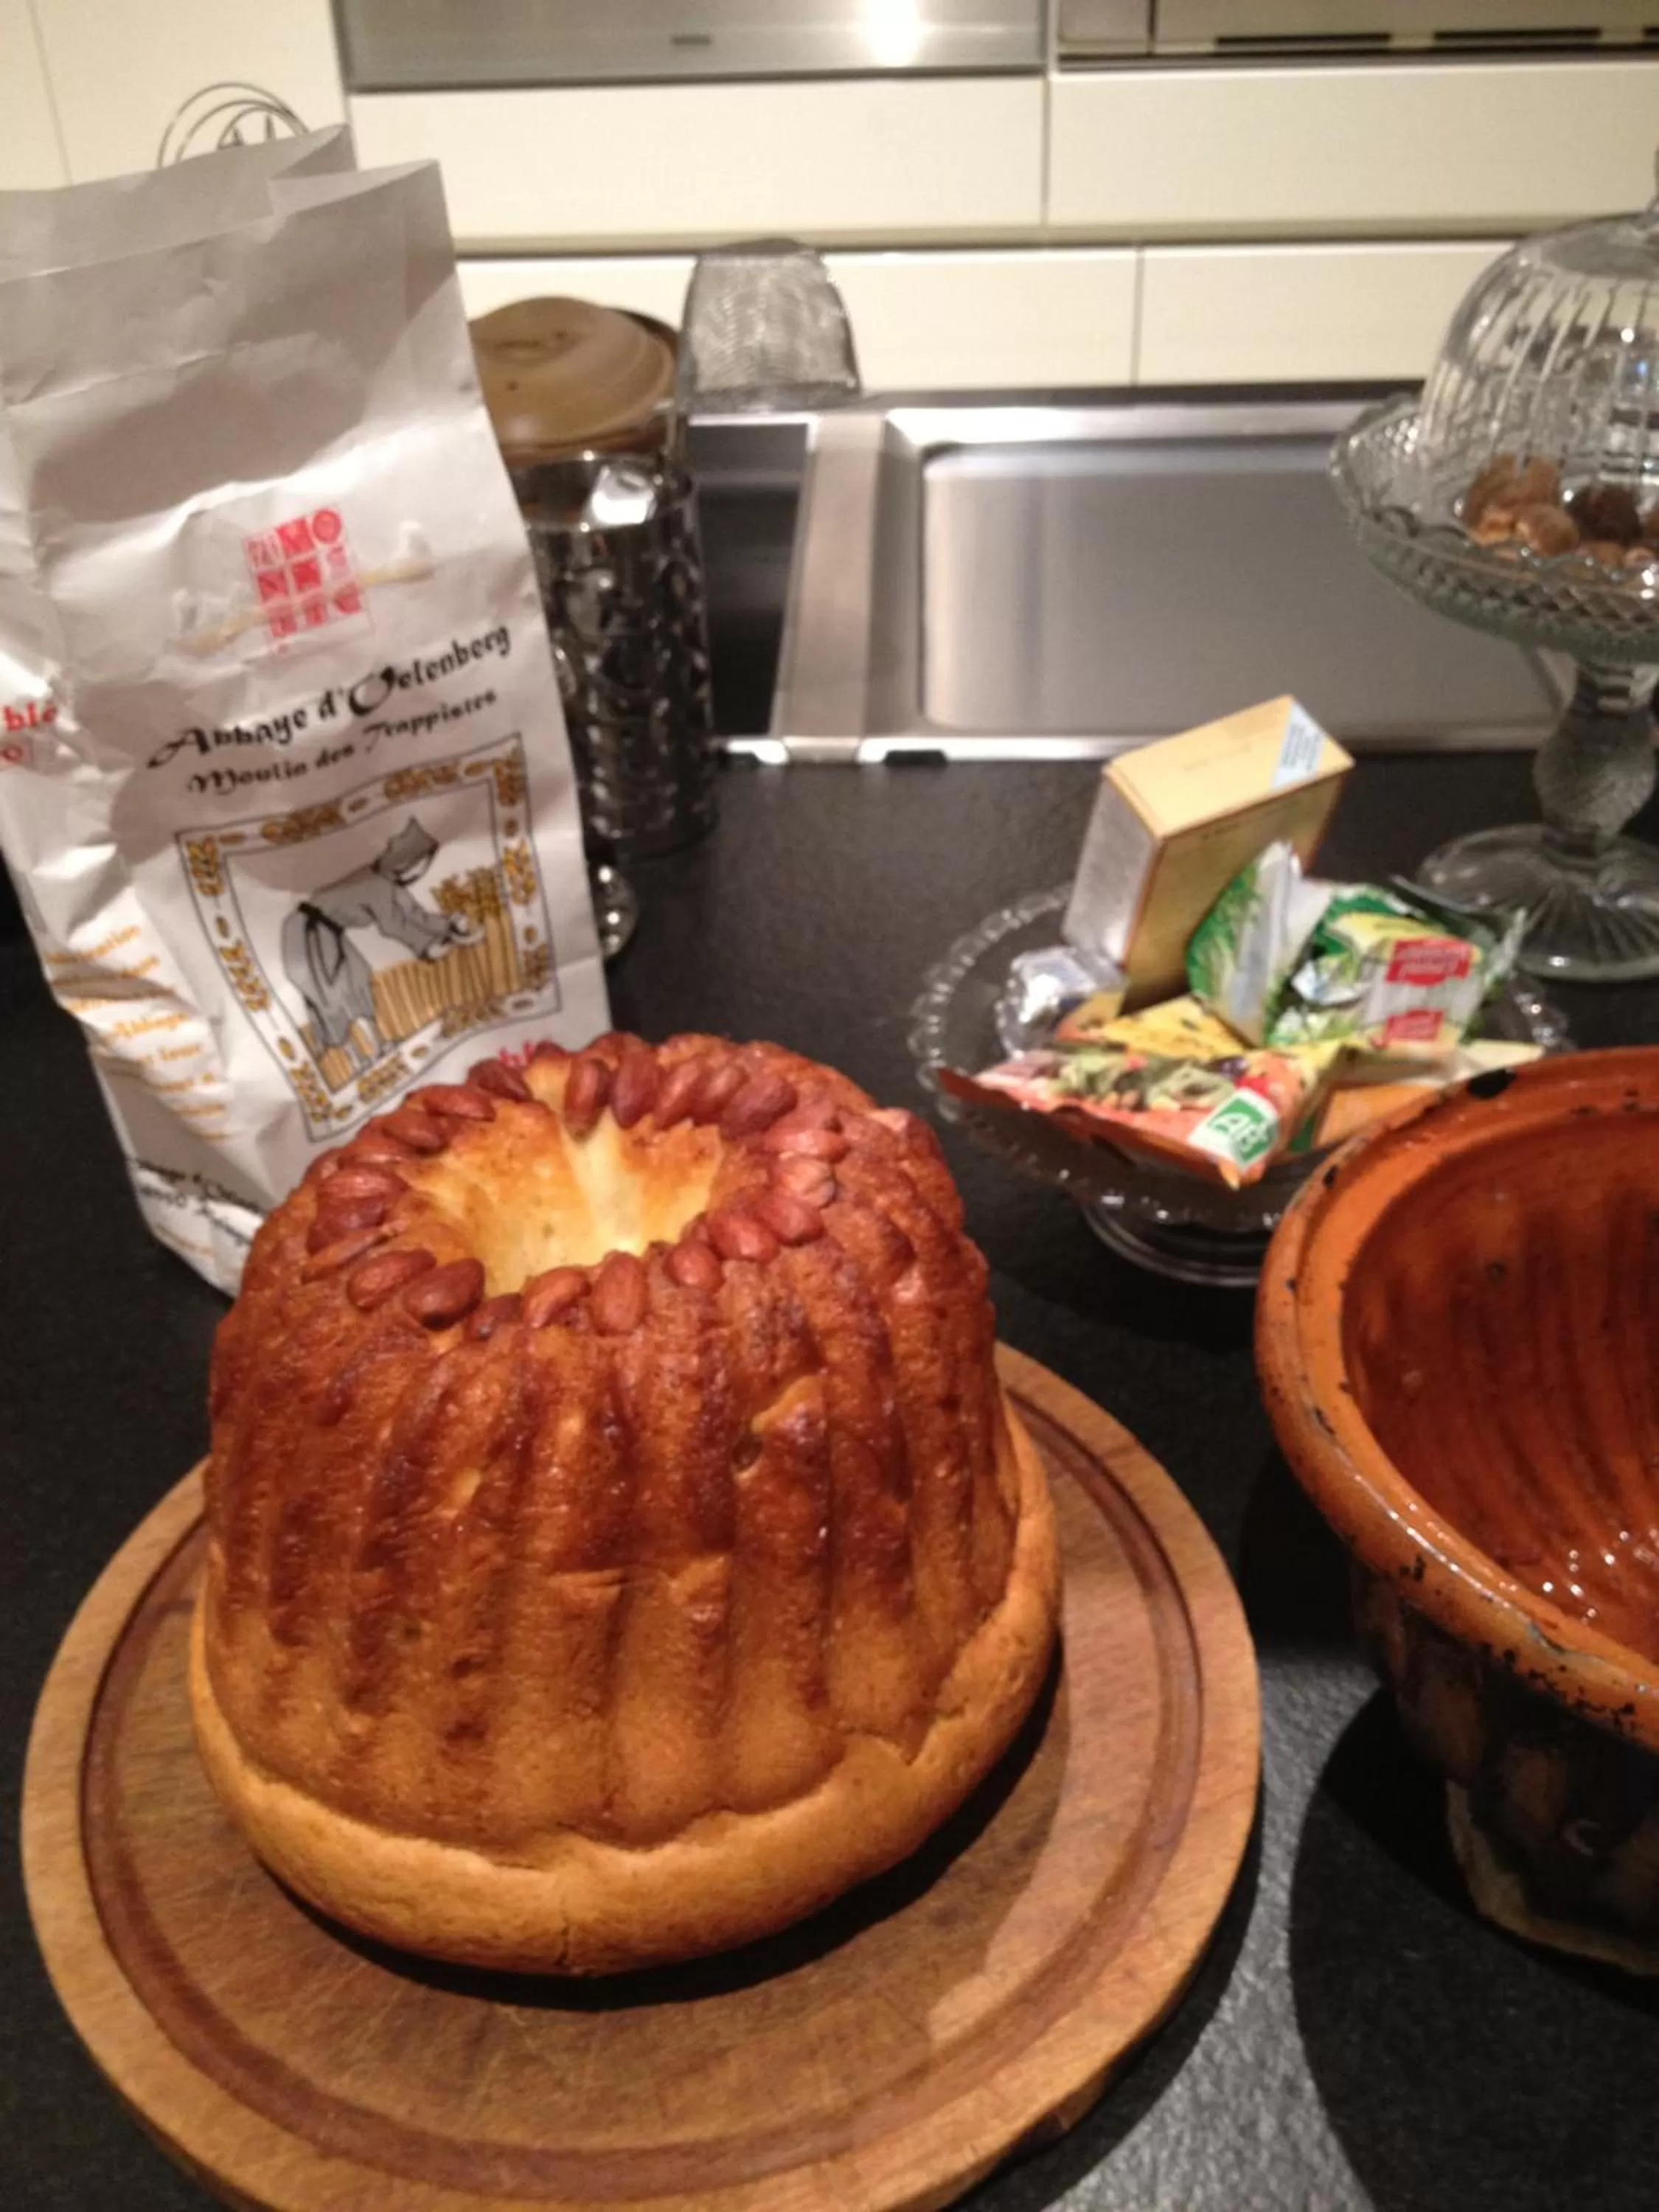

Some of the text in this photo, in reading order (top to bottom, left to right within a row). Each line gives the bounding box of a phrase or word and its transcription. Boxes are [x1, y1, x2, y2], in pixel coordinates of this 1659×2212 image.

[147, 625, 510, 768] Abbaye d'Oelenberg
[188, 689, 496, 795] Moulin des Trappistes
[1211, 1112, 1270, 1152] AB
